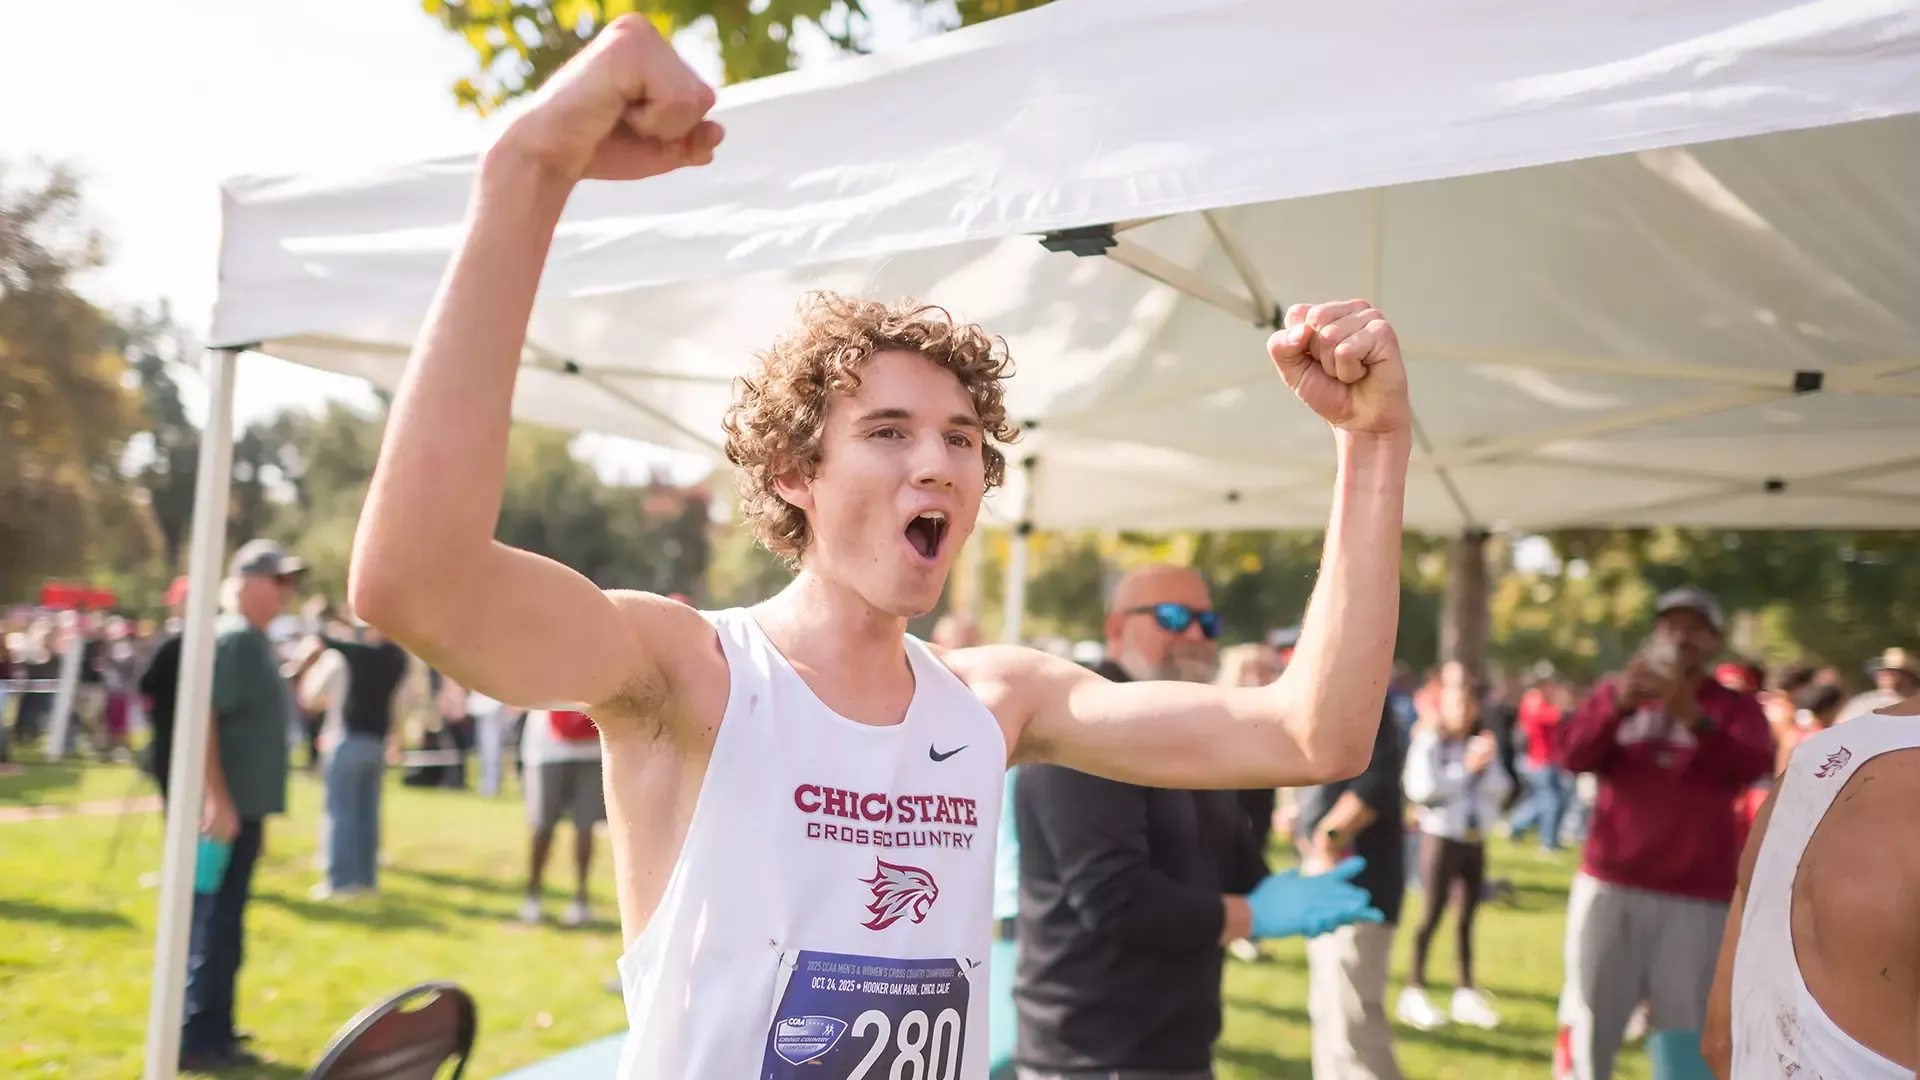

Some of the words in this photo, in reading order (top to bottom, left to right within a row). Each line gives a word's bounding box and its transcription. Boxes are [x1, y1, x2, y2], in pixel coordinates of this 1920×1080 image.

[896, 795, 978, 827] STATE
[807, 822, 884, 846] CROSS
[882, 831, 973, 849] COUNTRY
[807, 960, 821, 971] 2025
[821, 962, 837, 973] CCAA
[837, 964, 856, 975] MEN'S
[856, 966, 861, 975] &
[811, 976, 826, 989] OCT.
[838, 979, 856, 992] 2025
[862, 980, 889, 994] HOOKER
[889, 982, 903, 995] OAK
[788, 1018, 806, 1026] CCAA
[846, 1007, 961, 1080] 280
